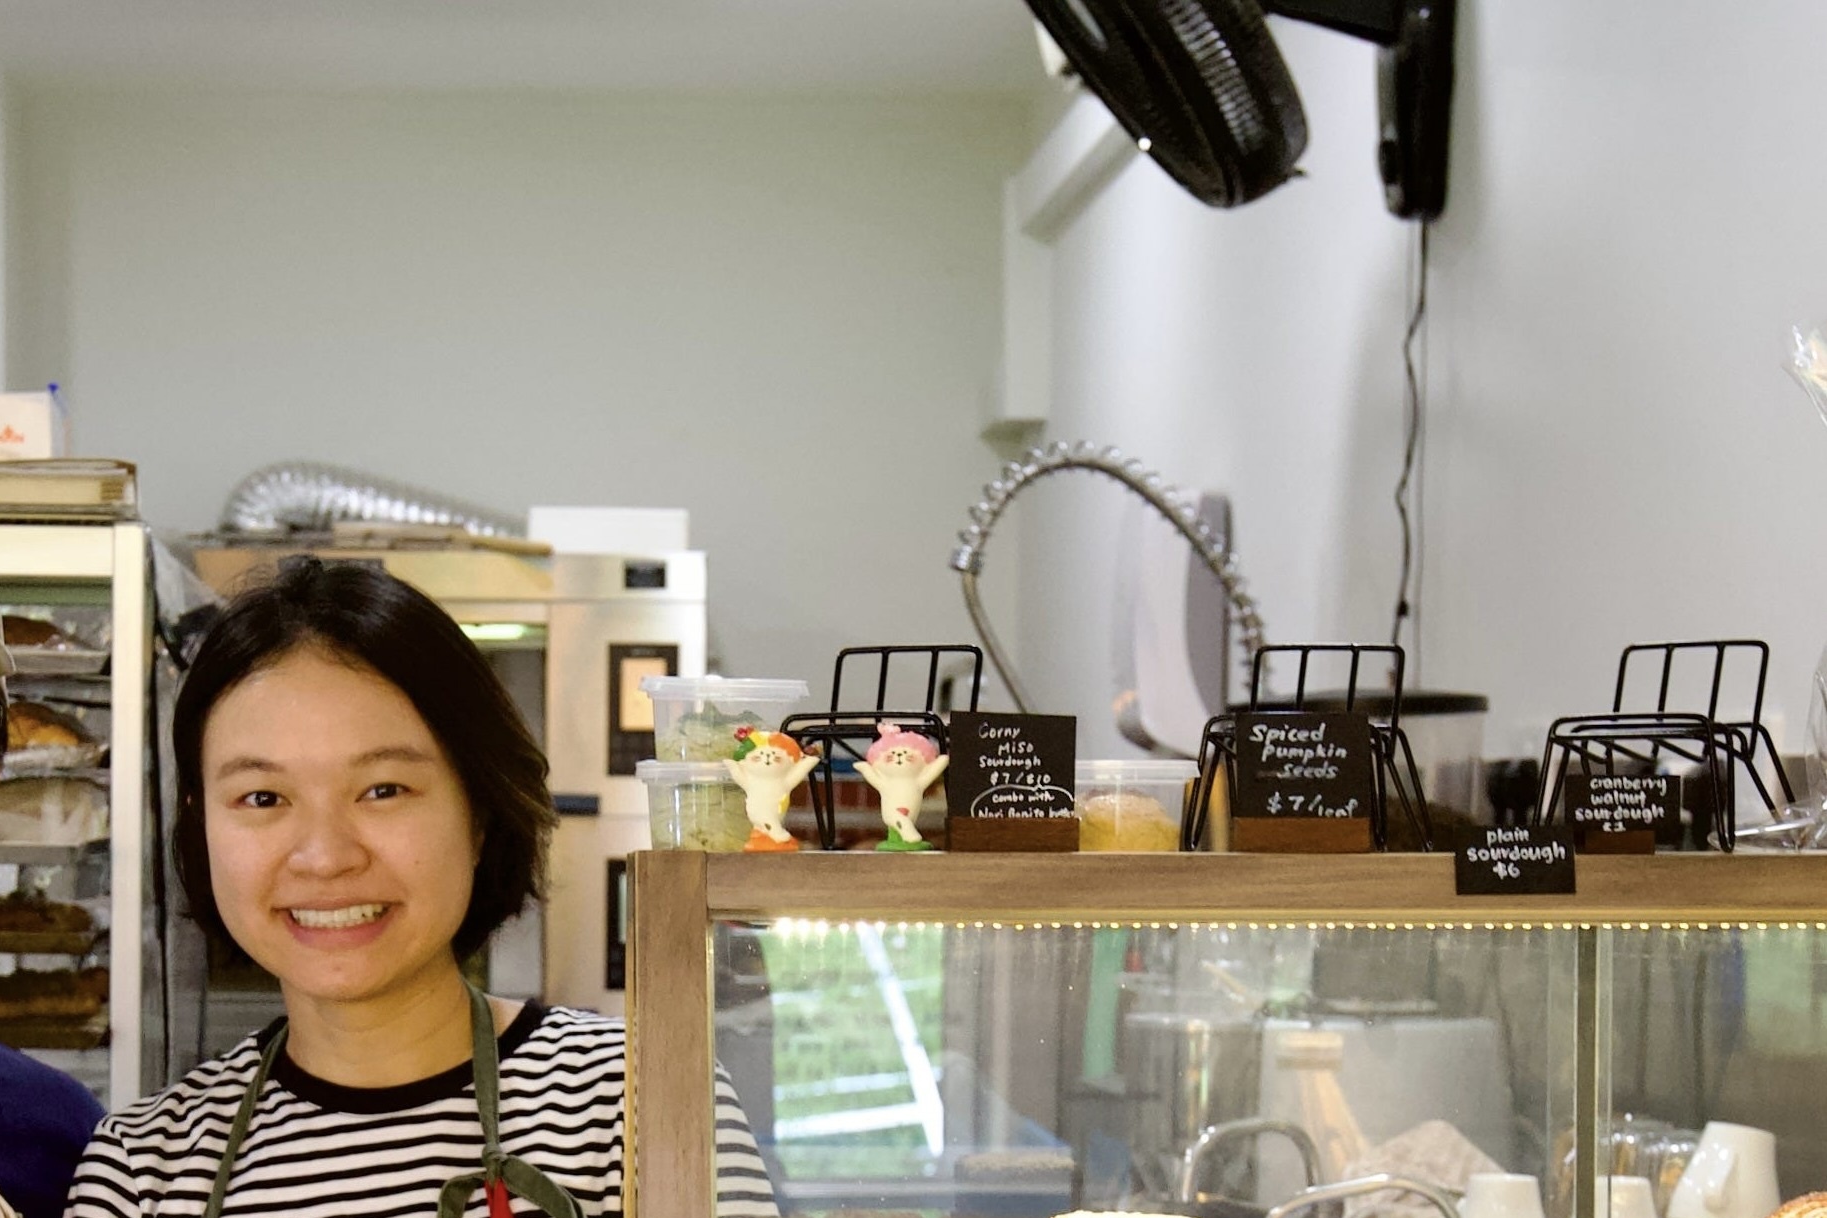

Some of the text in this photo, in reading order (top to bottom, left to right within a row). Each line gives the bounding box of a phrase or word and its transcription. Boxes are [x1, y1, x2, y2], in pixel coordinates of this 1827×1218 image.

[978, 721, 1021, 739] Corny
[1249, 721, 1326, 746] Spiced
[1589, 776, 1667, 797] cranberry
[1590, 789, 1646, 809] walnut
[1486, 827, 1530, 847] plain
[1466, 842, 1567, 865] sourdough
[1493, 862, 1521, 880] $6
